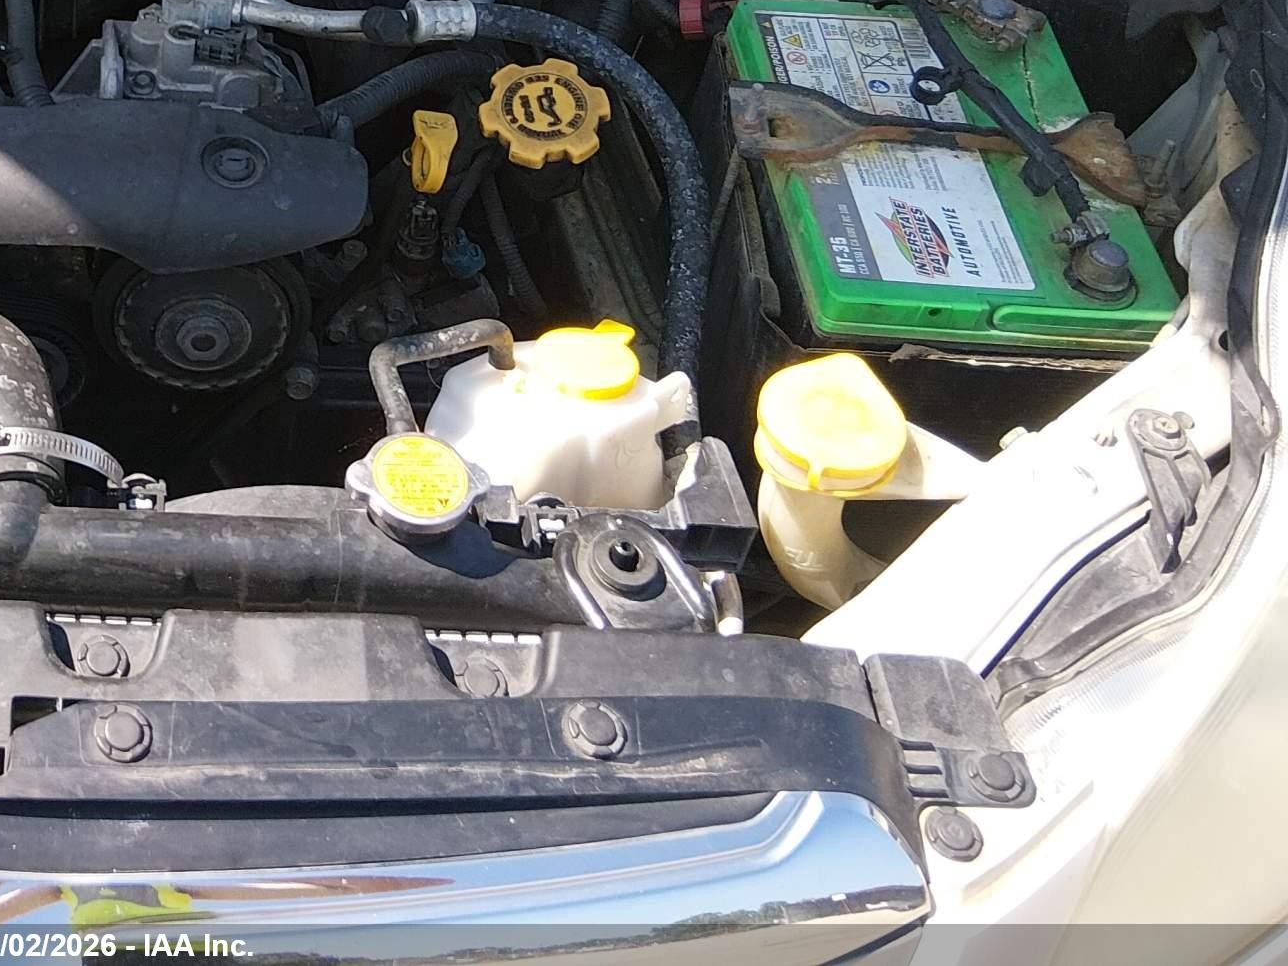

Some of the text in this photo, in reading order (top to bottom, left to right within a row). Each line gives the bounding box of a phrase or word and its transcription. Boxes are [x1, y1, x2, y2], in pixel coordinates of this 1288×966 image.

[830, 235, 857, 275] MT-35
[893, 200, 931, 275] INTERSTATE
[911, 207, 946, 275] BATTERIES
[942, 205, 983, 277] AUTOMOTIVE
